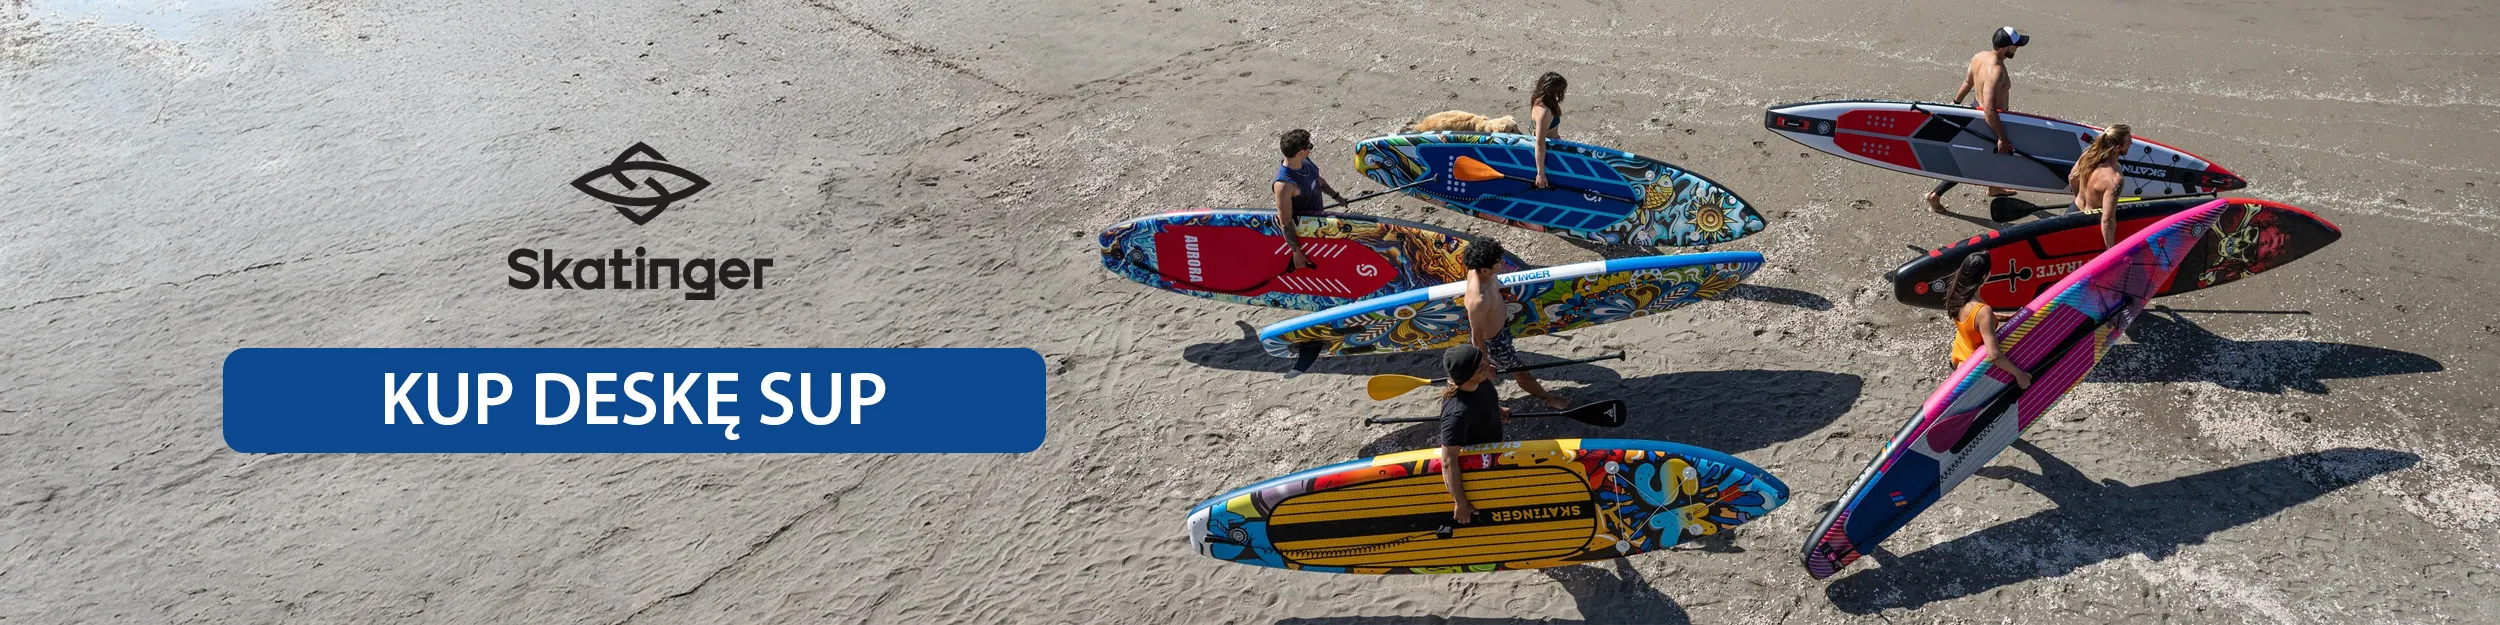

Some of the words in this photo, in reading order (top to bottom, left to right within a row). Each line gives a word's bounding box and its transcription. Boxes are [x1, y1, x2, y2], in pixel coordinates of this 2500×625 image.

[1184, 234, 1203, 282] AURORA
[2036, 260, 2091, 278] IRATE
[1459, 441, 1522, 452] SKATIN
[1491, 505, 1581, 522] SKATINGER
